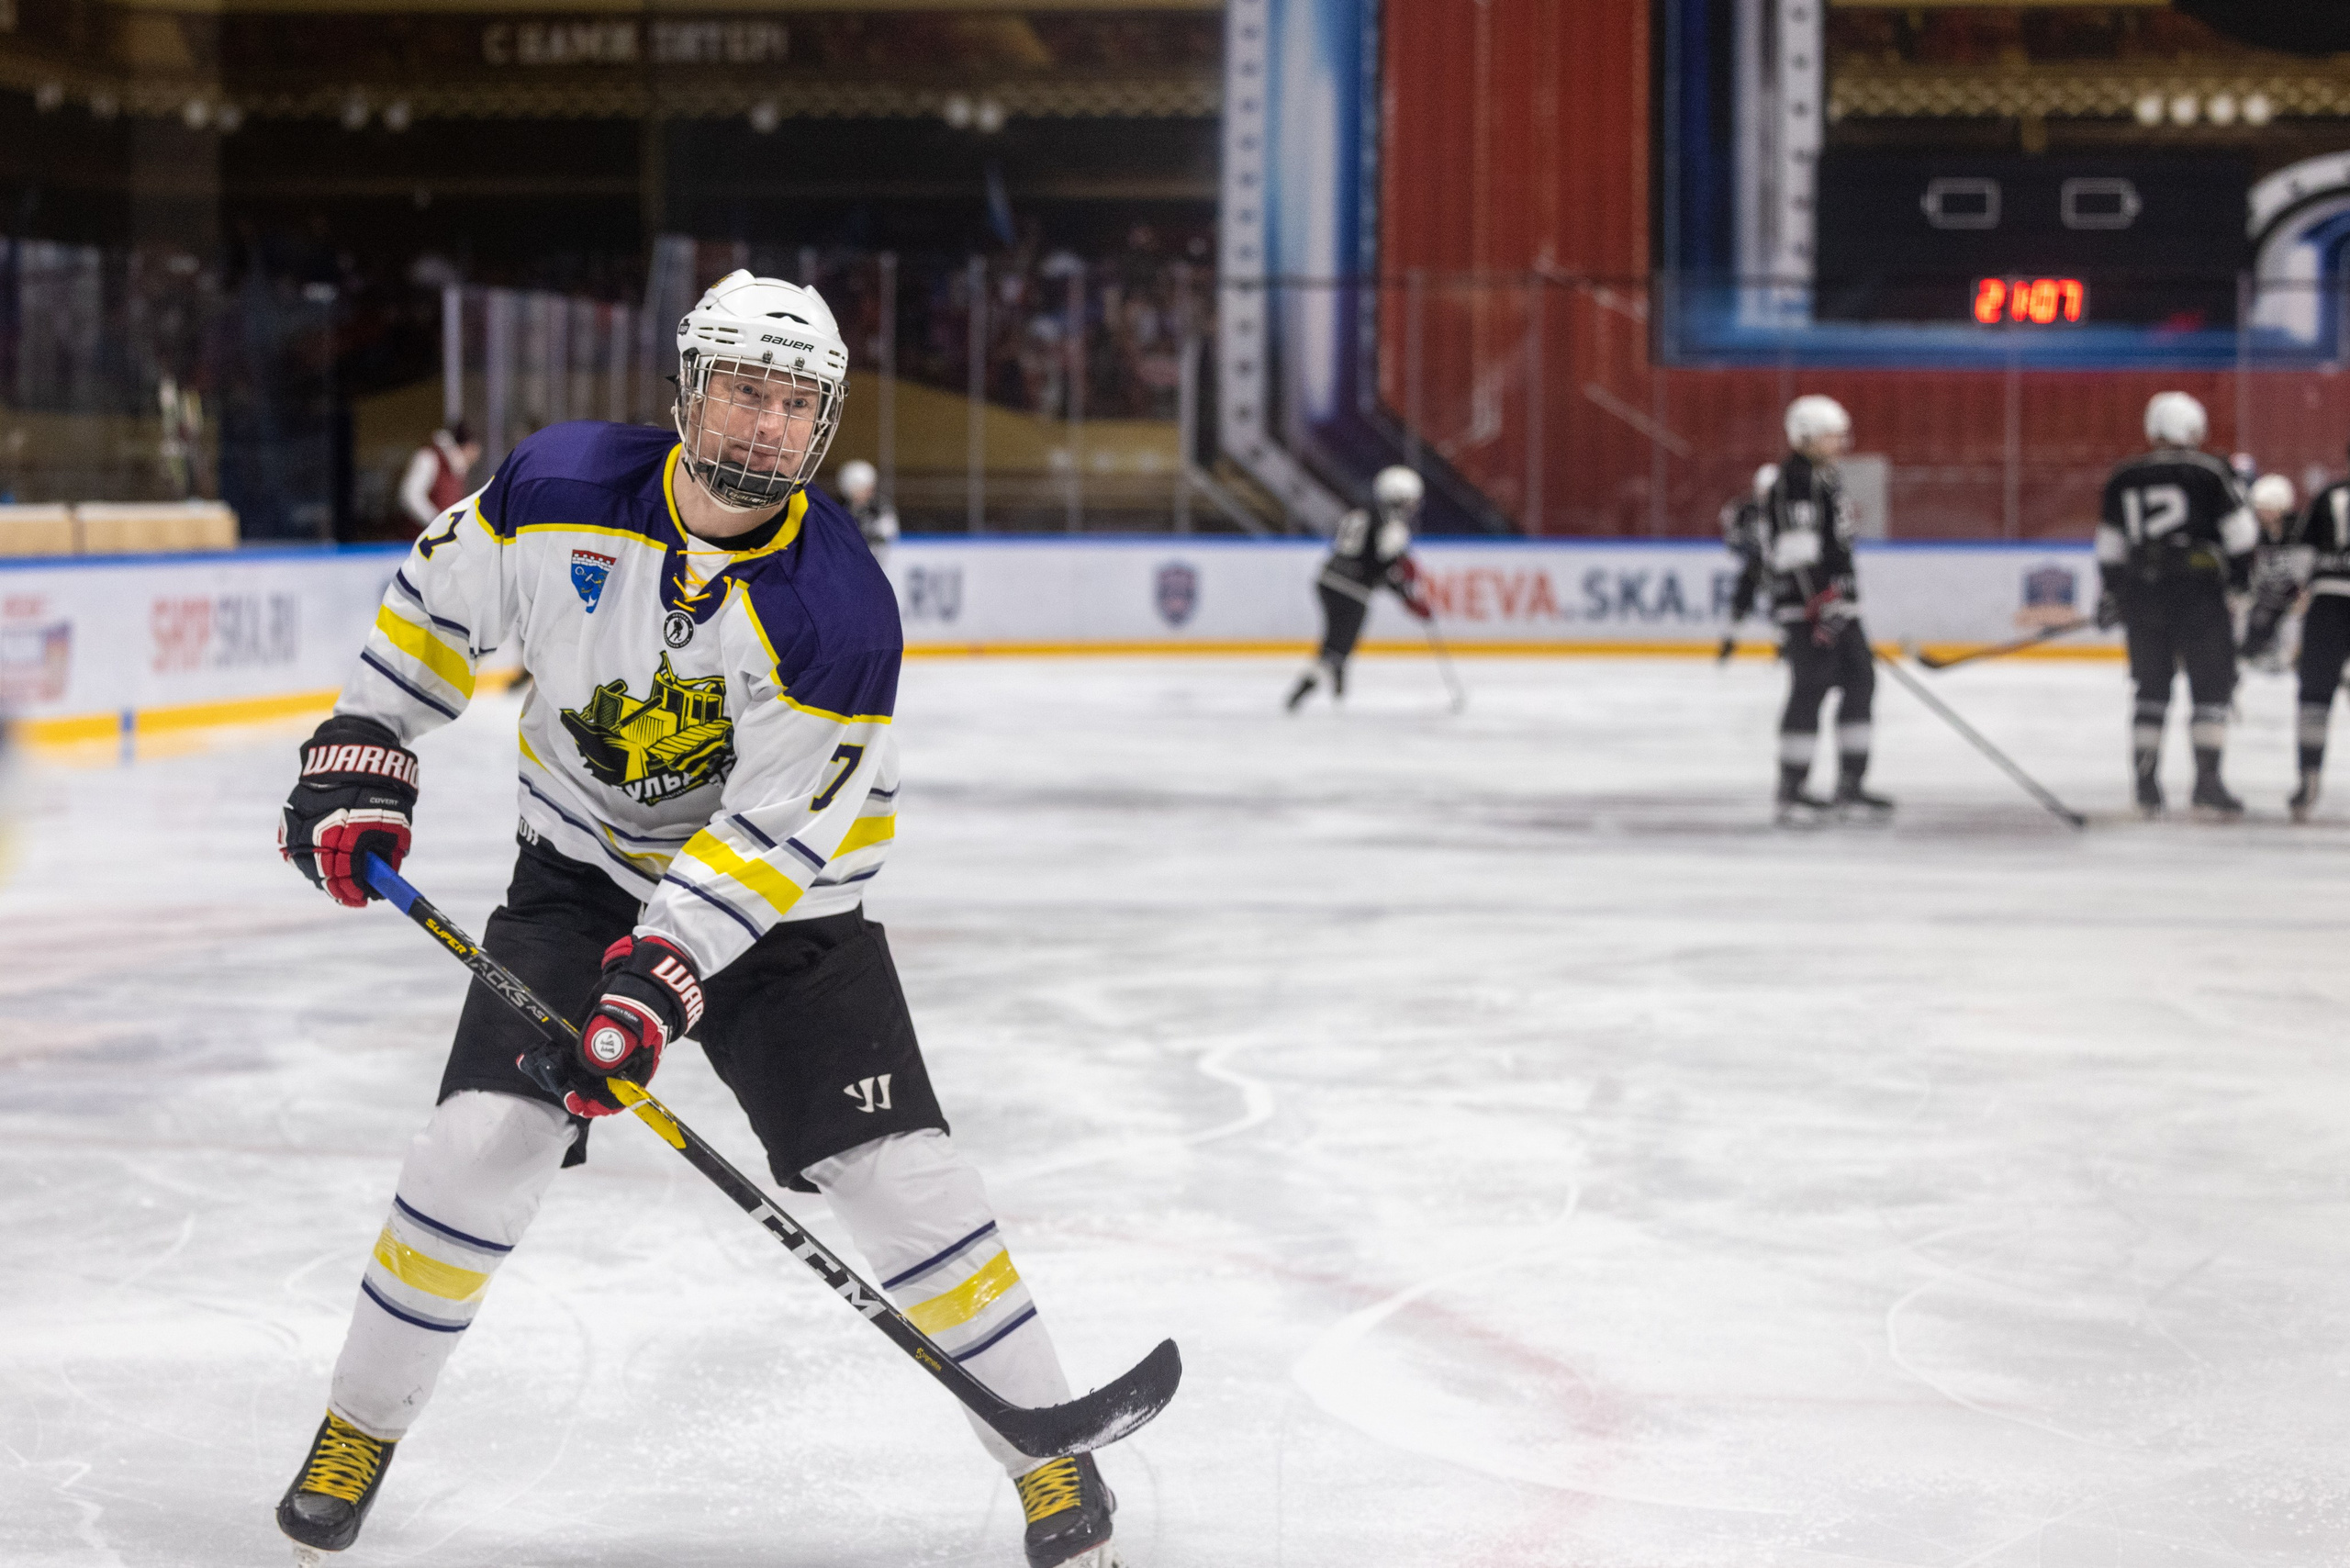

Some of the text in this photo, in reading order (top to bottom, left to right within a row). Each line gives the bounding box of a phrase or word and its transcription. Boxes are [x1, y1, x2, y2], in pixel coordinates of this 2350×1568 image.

[419, 509, 467, 561] 7
[2121, 484, 2188, 545] 12
[2329, 487, 2350, 549] 1
[1423, 566, 1737, 619] NEVA.SKA.R
[302, 745, 420, 790] WARRIO
[809, 742, 866, 813] 7
[369, 796, 399, 807] COVERT
[425, 918, 467, 955] SUPER
[525, 1004, 550, 1024] AS1
[650, 955, 705, 1036] WAR
[748, 1197, 889, 1321] CCM
